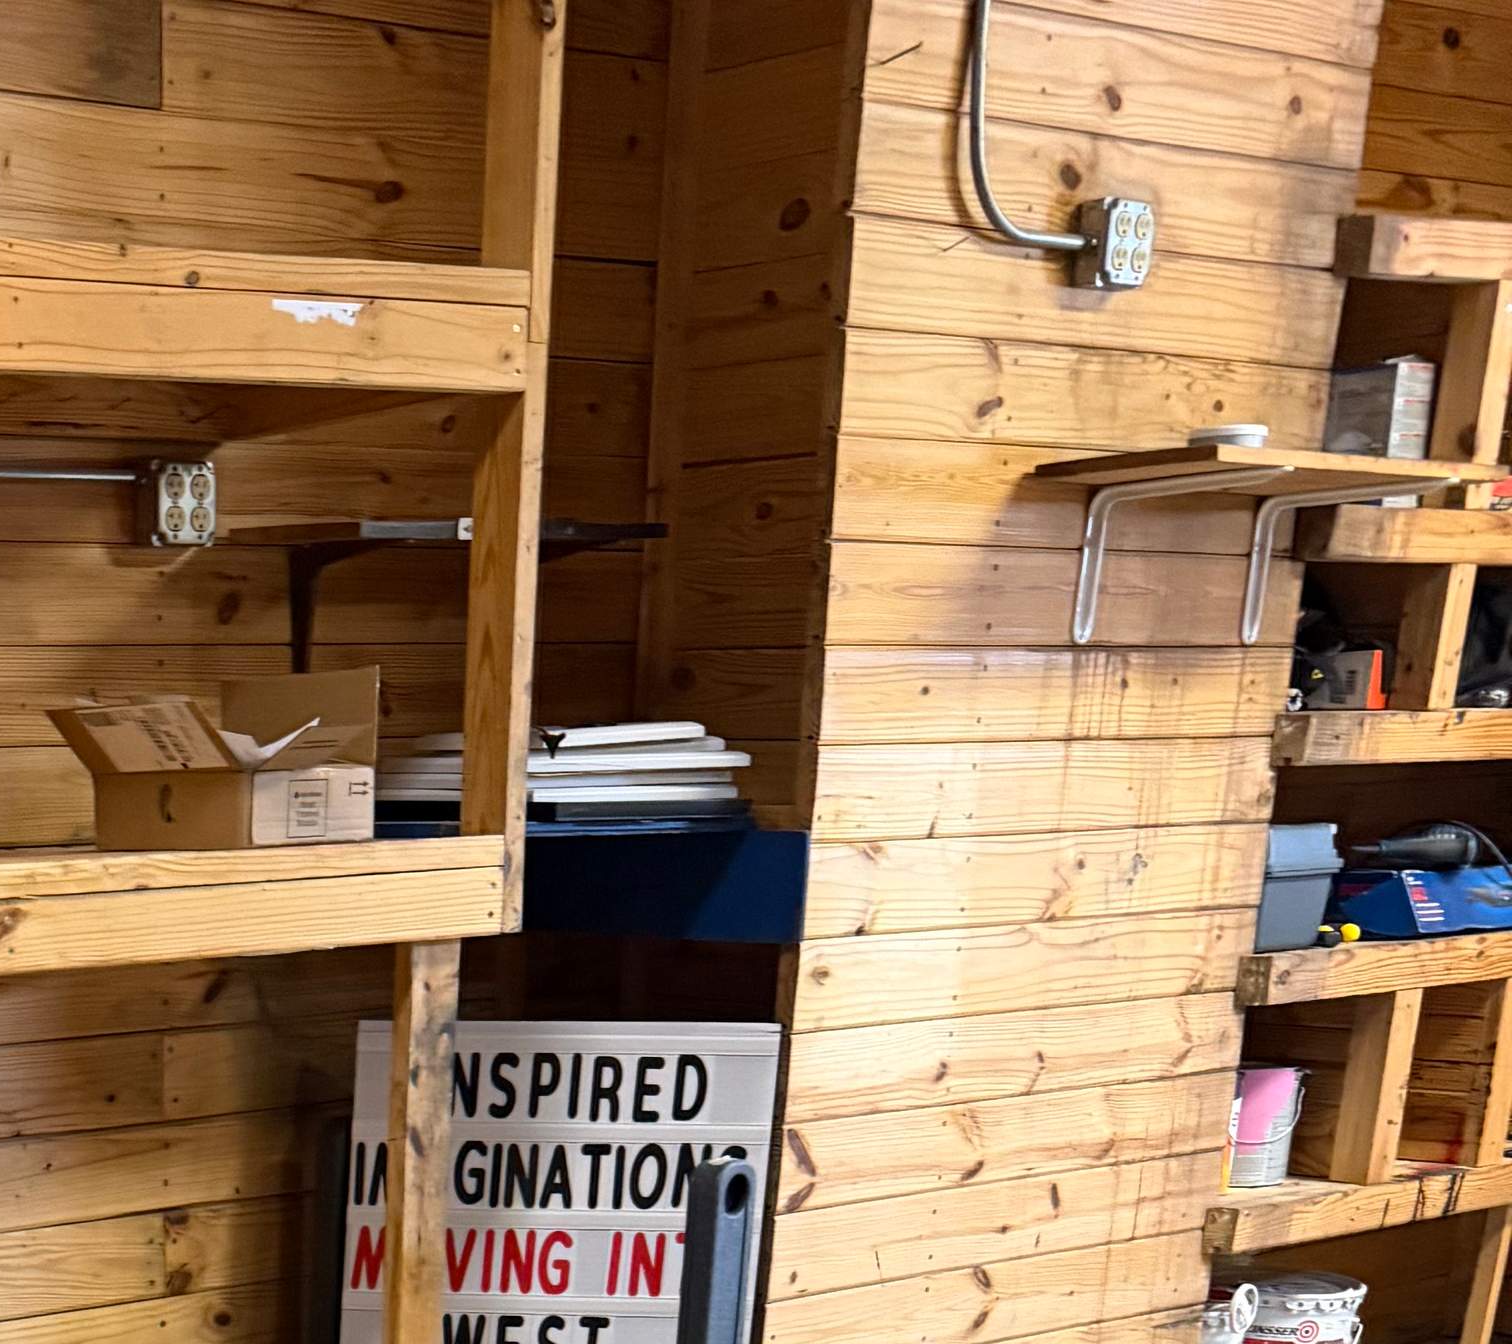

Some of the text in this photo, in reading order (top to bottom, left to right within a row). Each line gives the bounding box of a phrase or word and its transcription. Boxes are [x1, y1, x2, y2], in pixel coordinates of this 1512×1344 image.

[452, 1052, 708, 1123] NSPIRED
[354, 1140, 748, 1210] IGINATION
[351, 1225, 686, 1298] MVING IN
